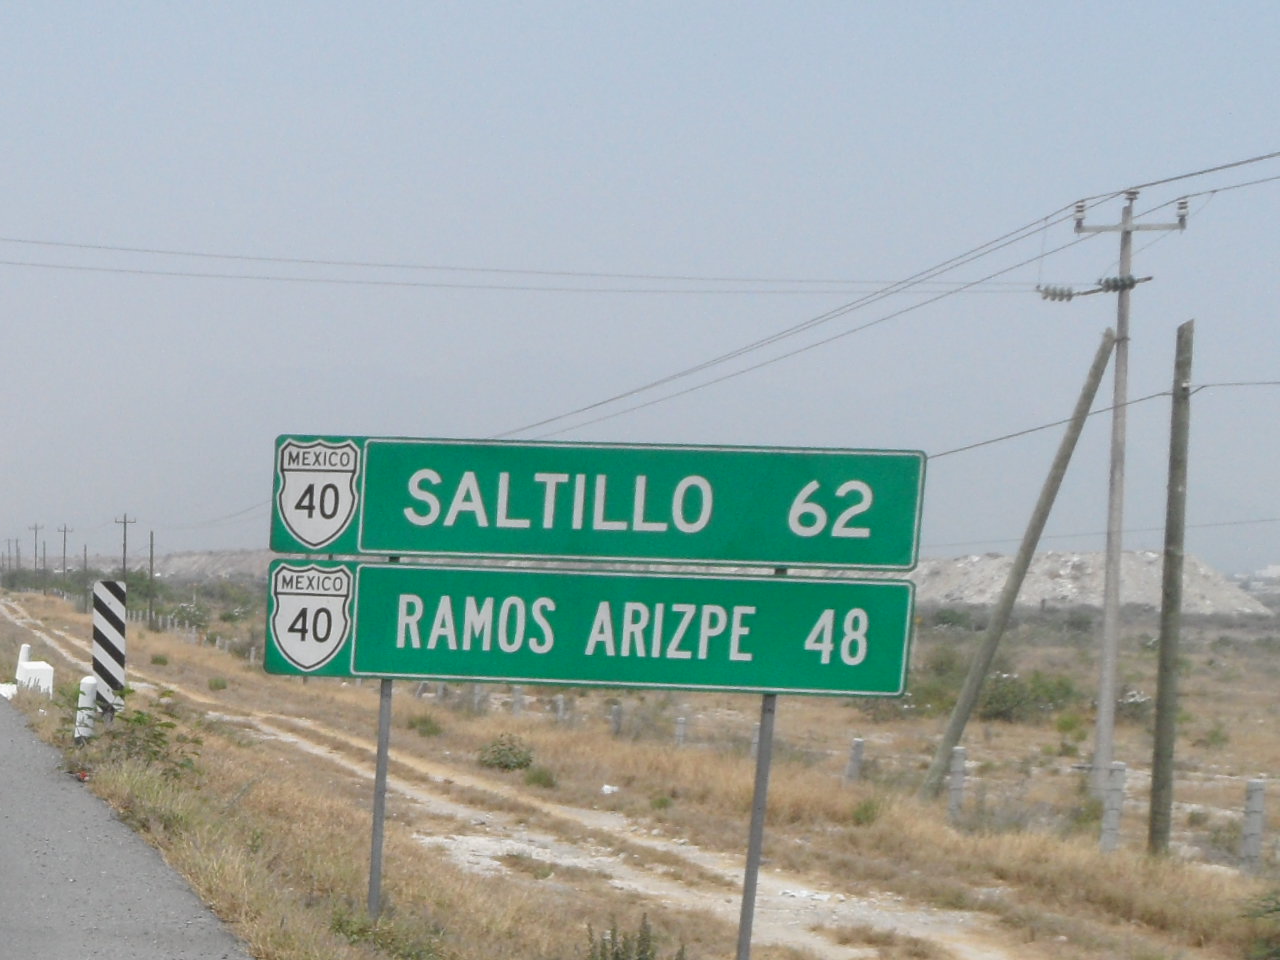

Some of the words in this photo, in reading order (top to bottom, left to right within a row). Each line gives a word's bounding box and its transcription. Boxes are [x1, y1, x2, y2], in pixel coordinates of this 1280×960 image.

[287, 451, 351, 467] MEXICO
[294, 483, 340, 520] 40
[403, 468, 713, 534] SALTILLO
[788, 479, 873, 538] 62
[281, 575, 344, 592] MEXICO
[287, 607, 333, 644] 40
[396, 594, 557, 655] RAMOS
[584, 601, 757, 662] ARIZPE
[804, 607, 869, 666] 48
